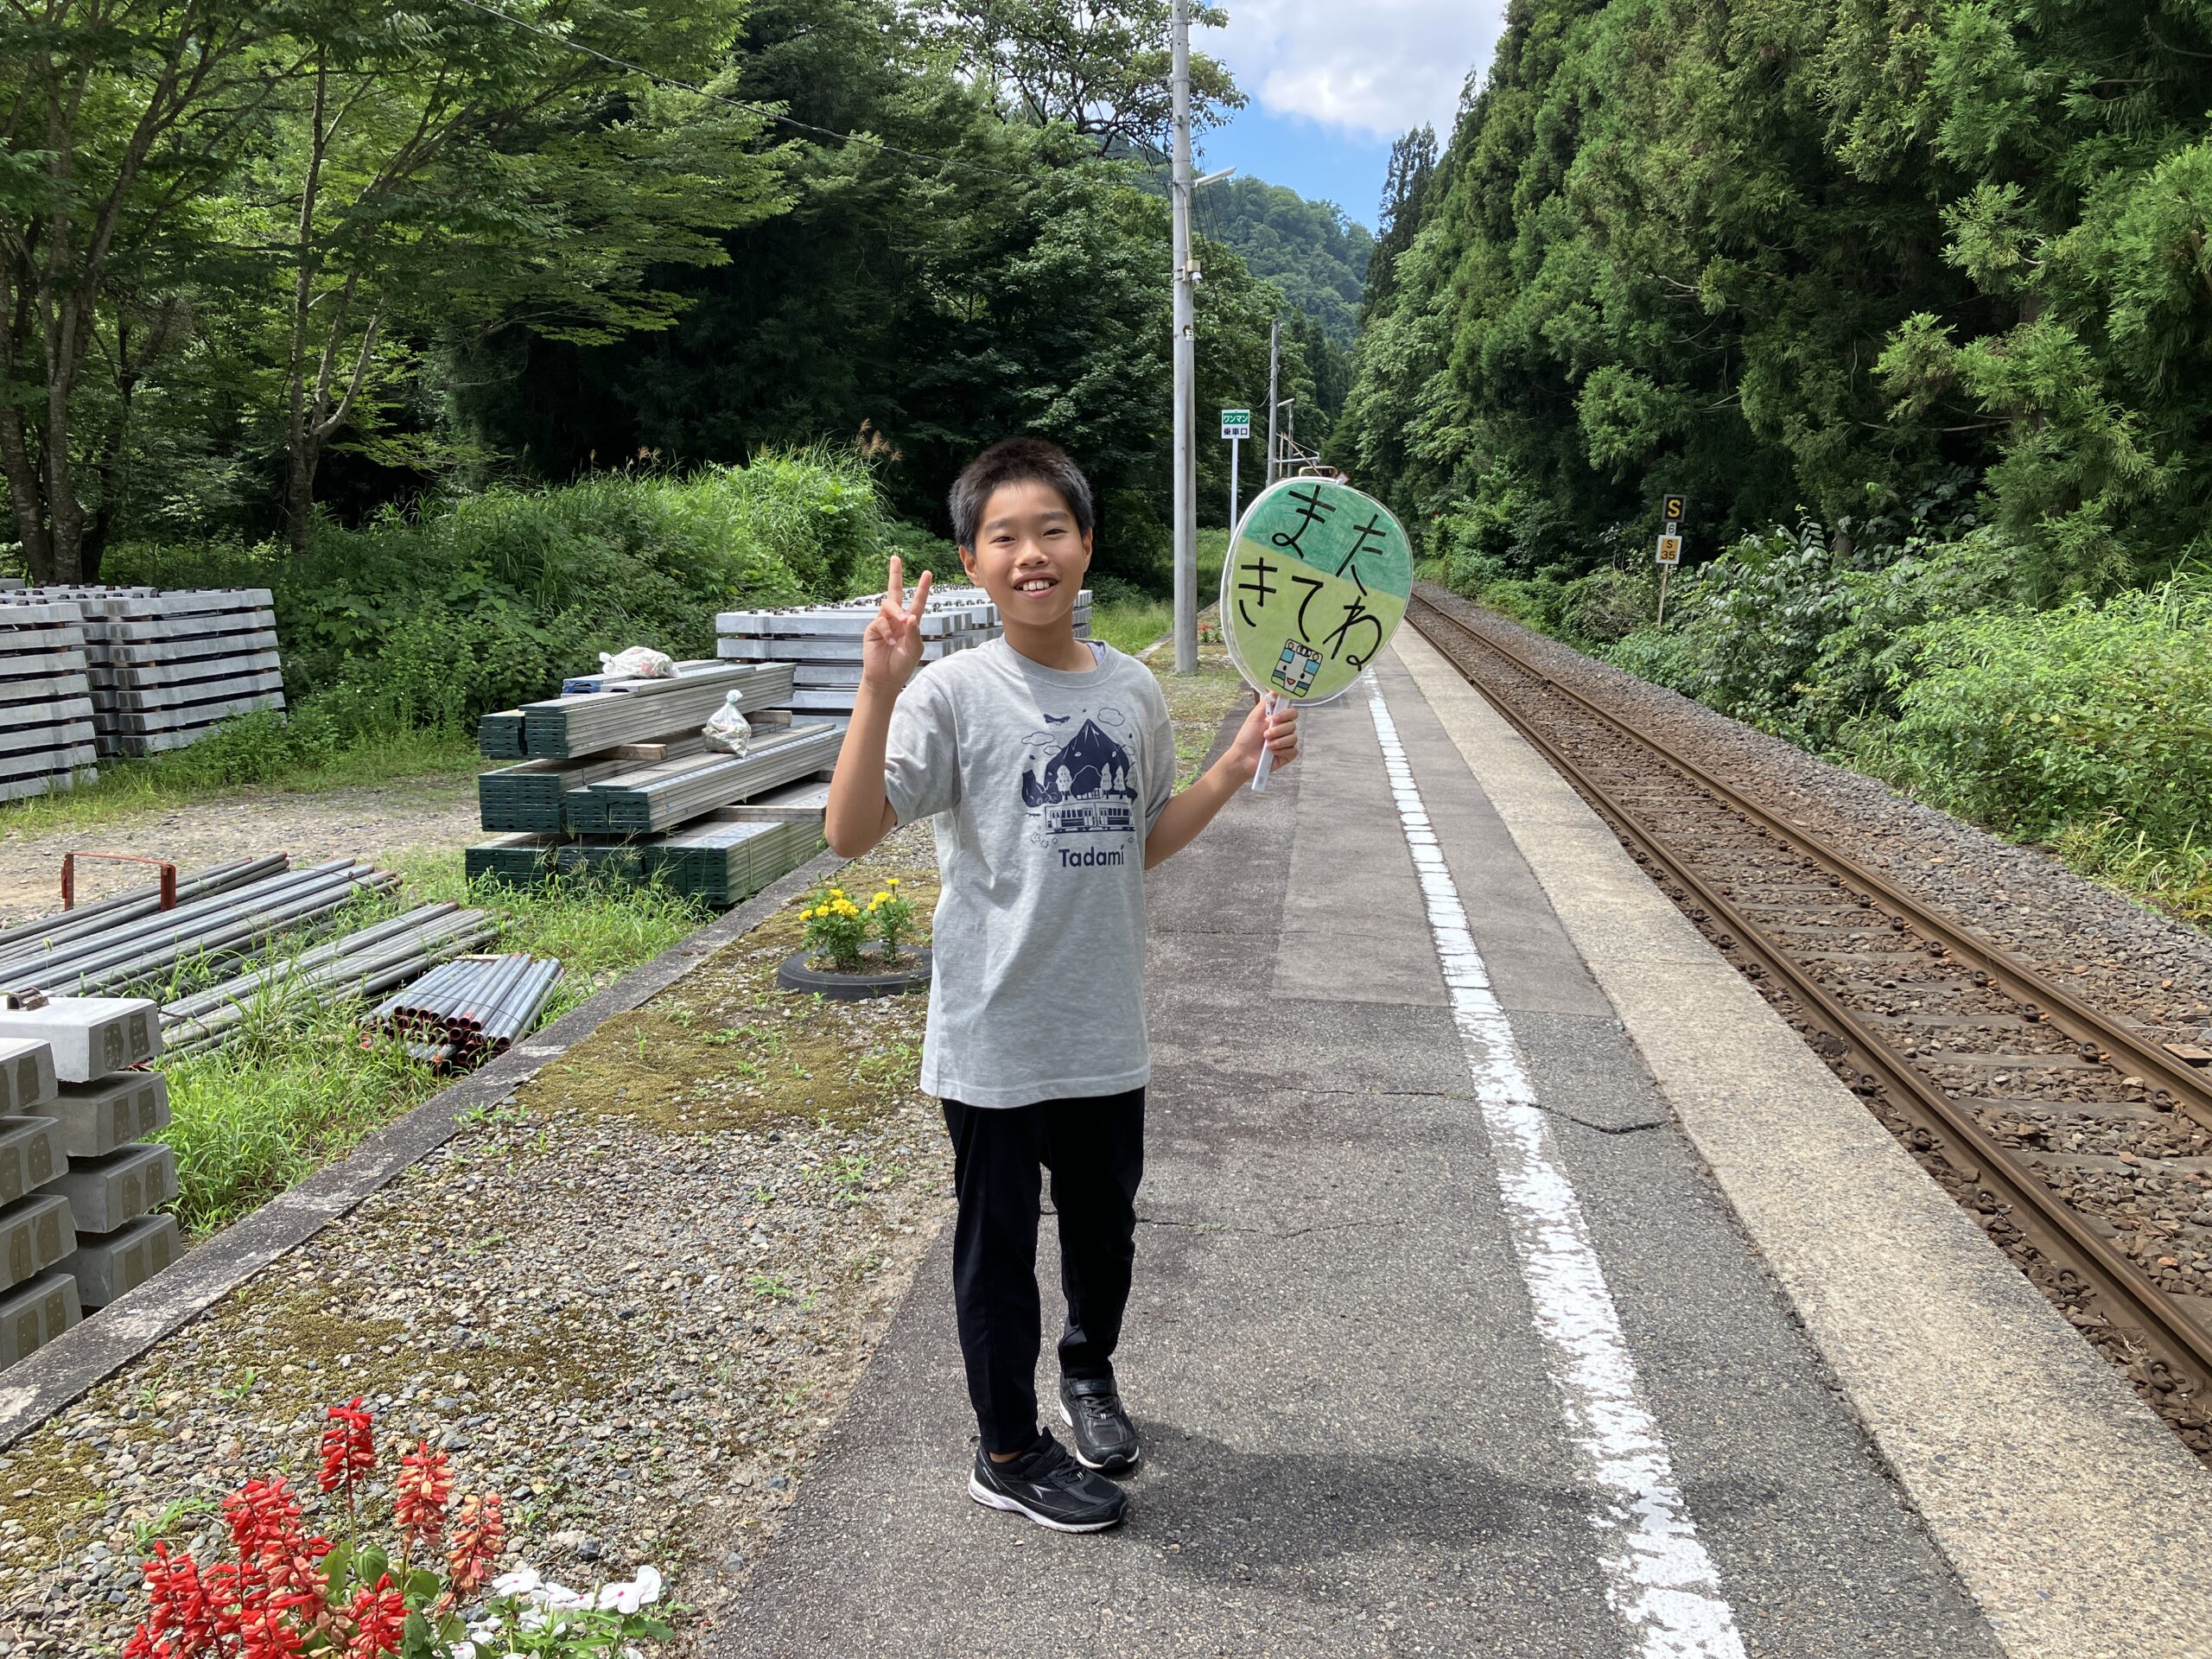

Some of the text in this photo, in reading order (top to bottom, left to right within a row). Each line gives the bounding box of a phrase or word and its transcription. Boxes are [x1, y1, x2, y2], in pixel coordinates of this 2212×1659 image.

[1224, 415, 1249, 423] ワンマン
[1667, 499, 1681, 518] S
[1668, 524, 1675, 534] 6
[1272, 485, 1387, 596] また
[1666, 539, 1674, 549] S
[1661, 550, 1675, 560] 35
[1238, 556, 1382, 671] きてね
[1058, 844, 1125, 868] Tadami
